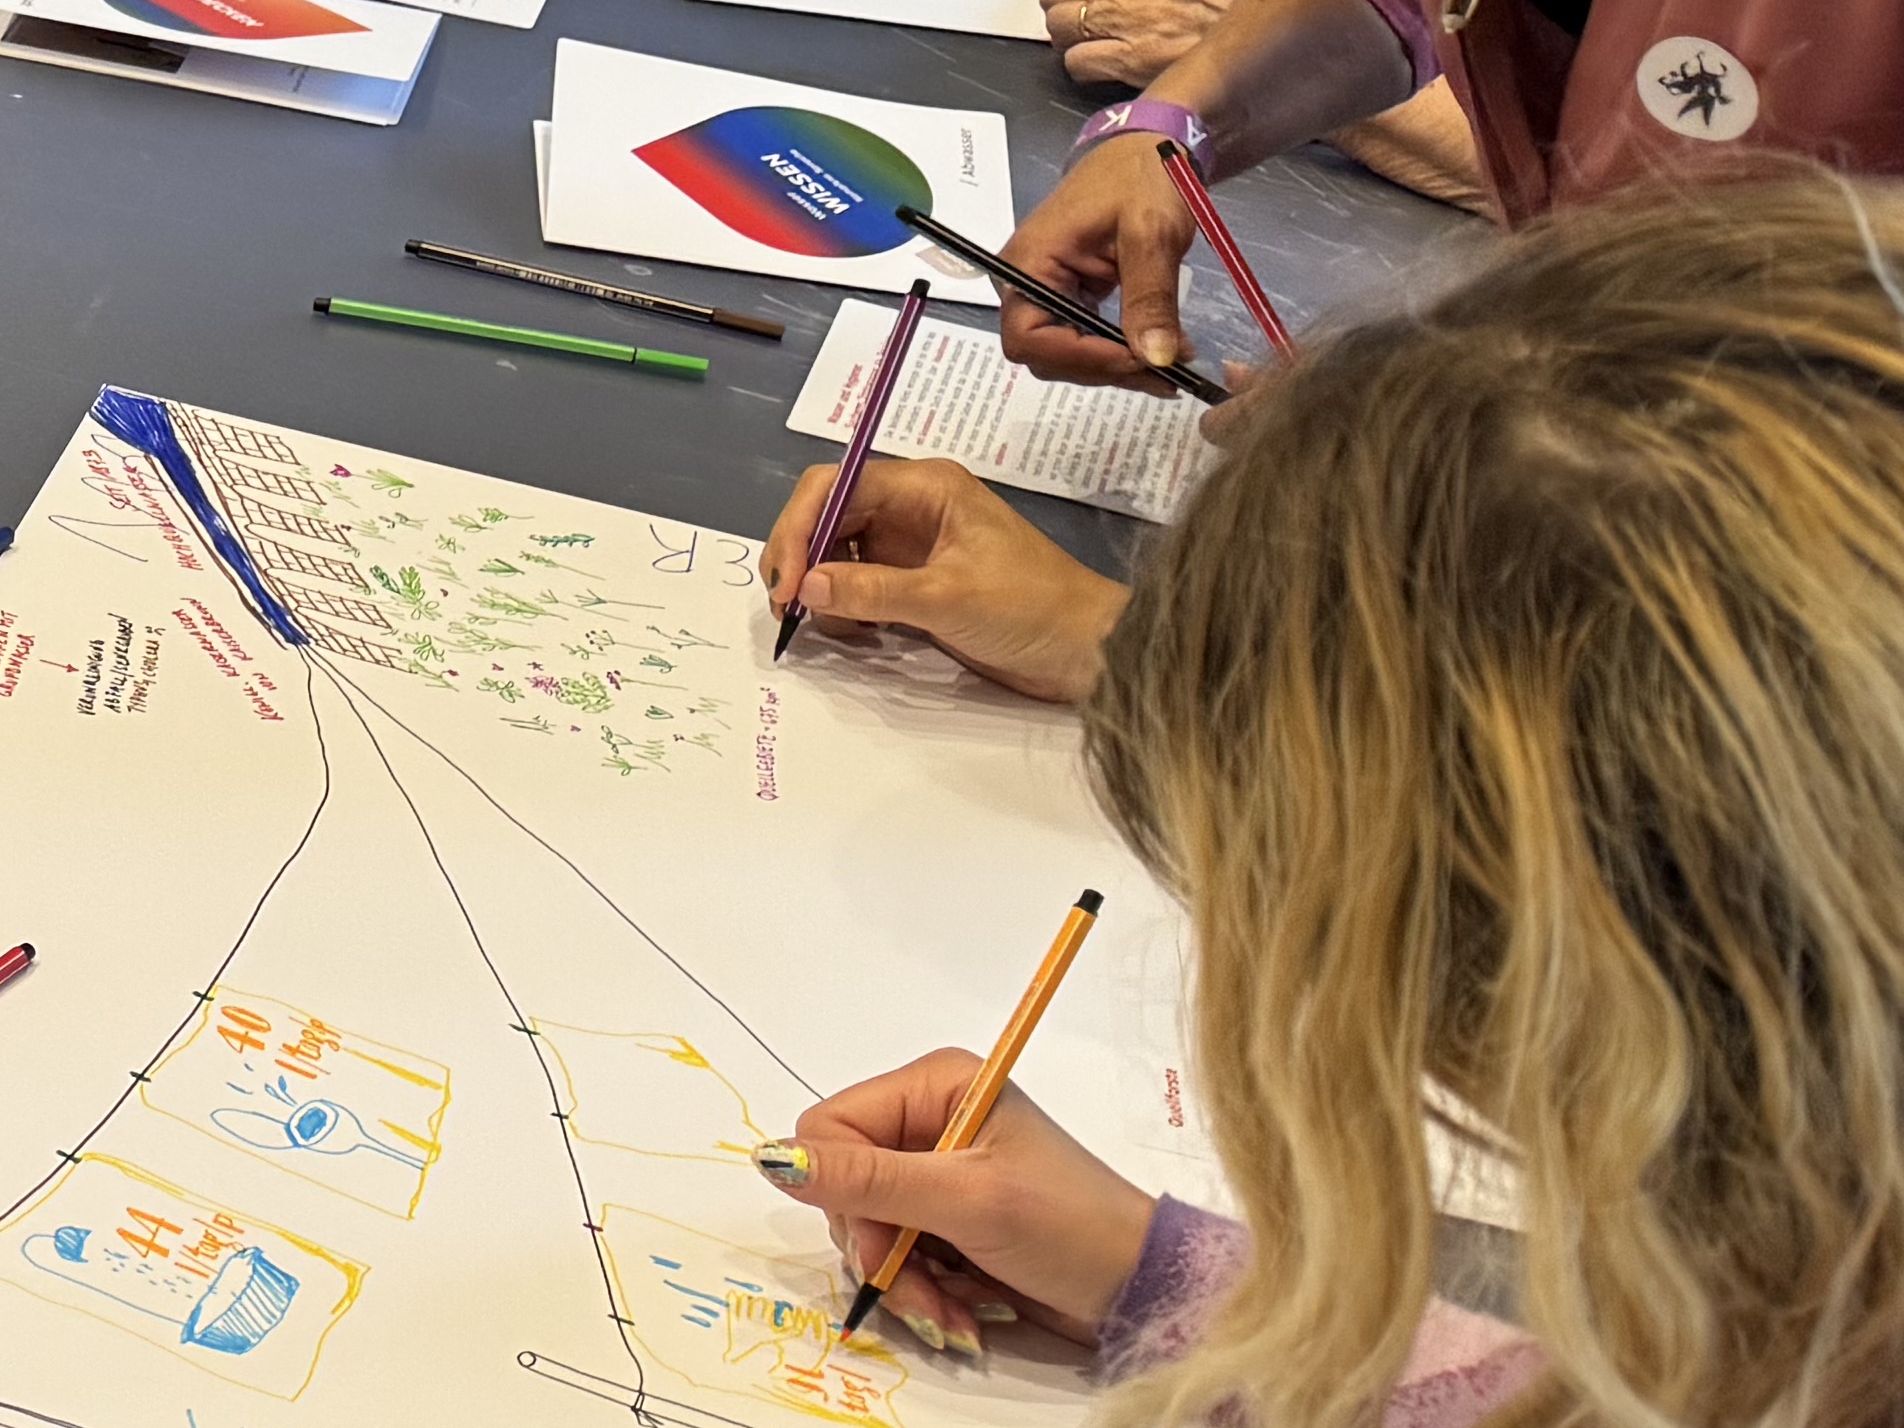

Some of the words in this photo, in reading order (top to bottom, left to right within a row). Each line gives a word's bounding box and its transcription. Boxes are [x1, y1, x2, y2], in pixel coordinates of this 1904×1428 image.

[960, 128, 976, 178] Abwasser
[760, 153, 850, 215] WISSEN
[217, 1006, 271, 1053] 40
[117, 1207, 183, 1258] 44
